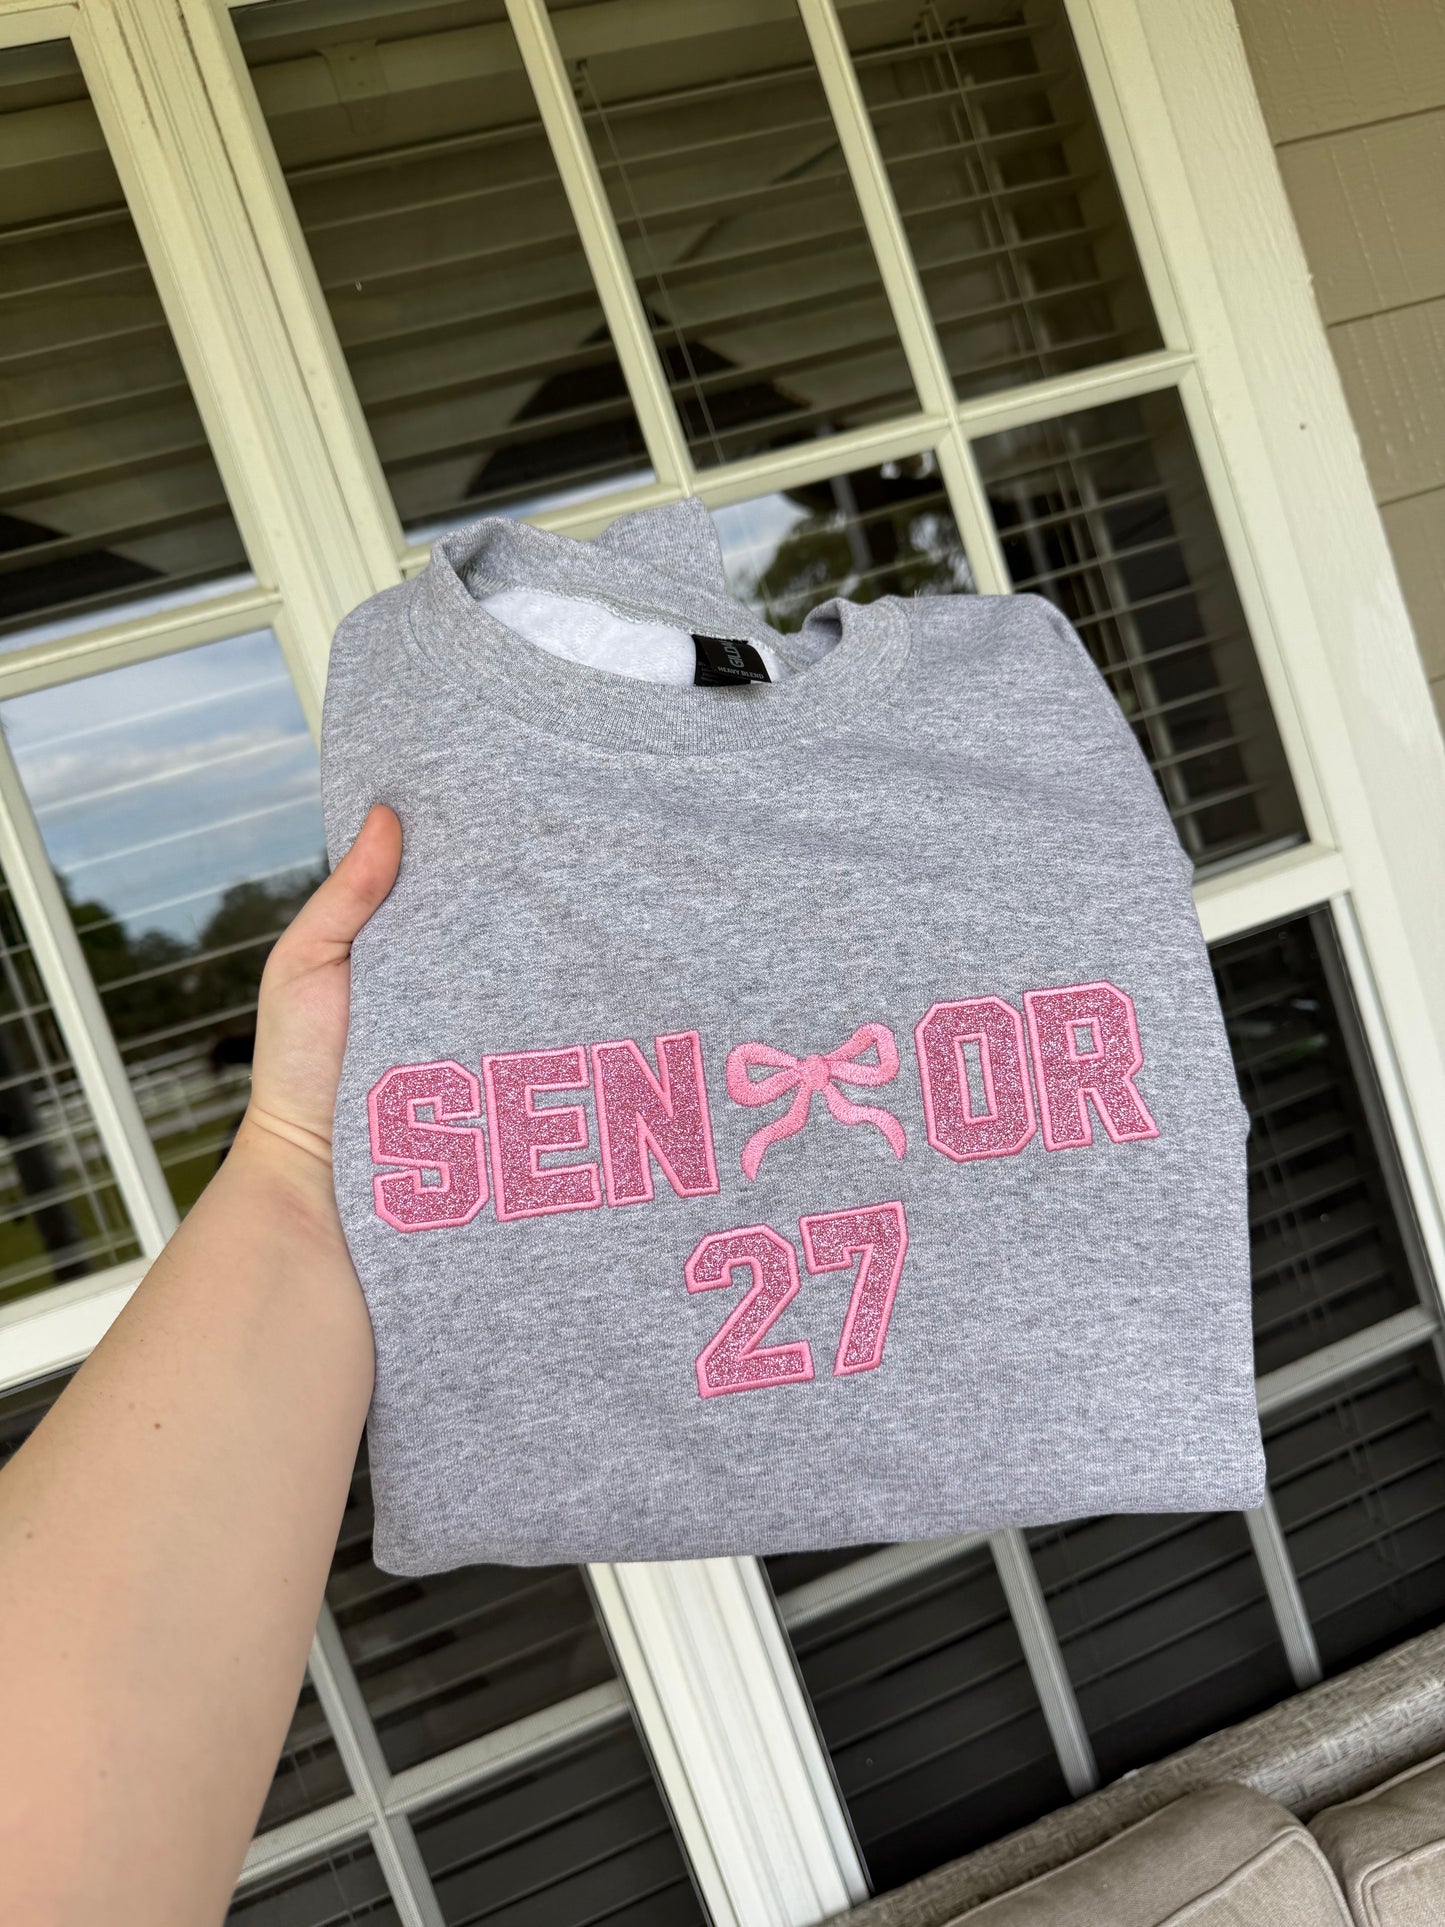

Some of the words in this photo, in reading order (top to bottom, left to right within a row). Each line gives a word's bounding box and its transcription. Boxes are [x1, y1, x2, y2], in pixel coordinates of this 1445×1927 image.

[717, 666, 740, 675] HEAVY
[740, 670, 764, 680] BLEND
[684, 1200, 908, 1399] 27
